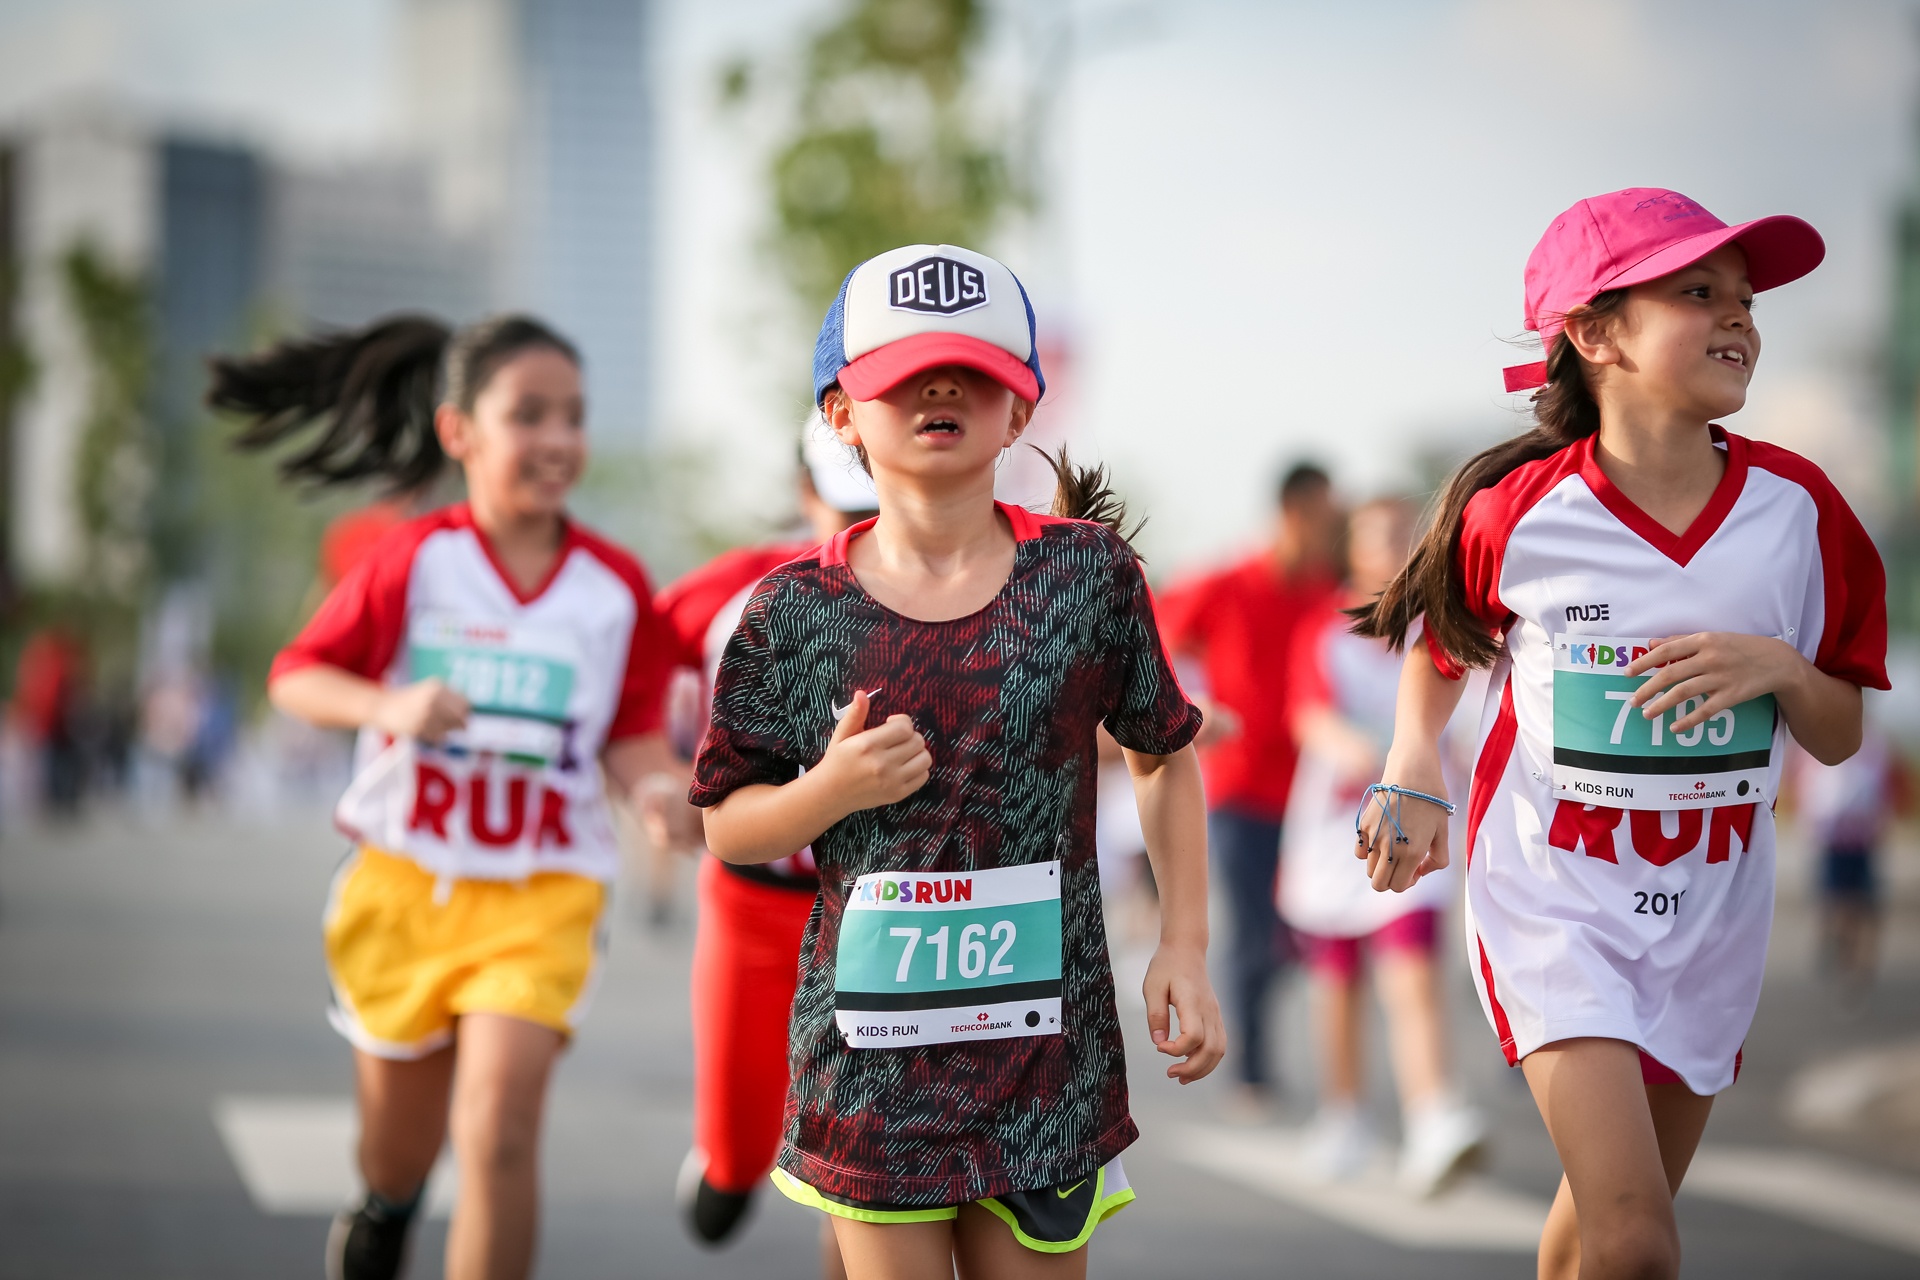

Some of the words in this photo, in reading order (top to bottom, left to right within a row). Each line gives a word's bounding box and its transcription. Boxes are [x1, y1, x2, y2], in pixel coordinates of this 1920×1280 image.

[1604, 690, 1736, 747] 7195
[1574, 781, 1603, 796] KIDS
[1605, 786, 1635, 799] RUN
[1668, 789, 1727, 801] TECHCOMBANK
[1633, 889, 1687, 916] 201
[889, 920, 1017, 983] 7162
[856, 1025, 889, 1037] KIDS
[891, 1024, 919, 1036] RUN
[950, 1020, 1013, 1033] TECHCOMBANK
